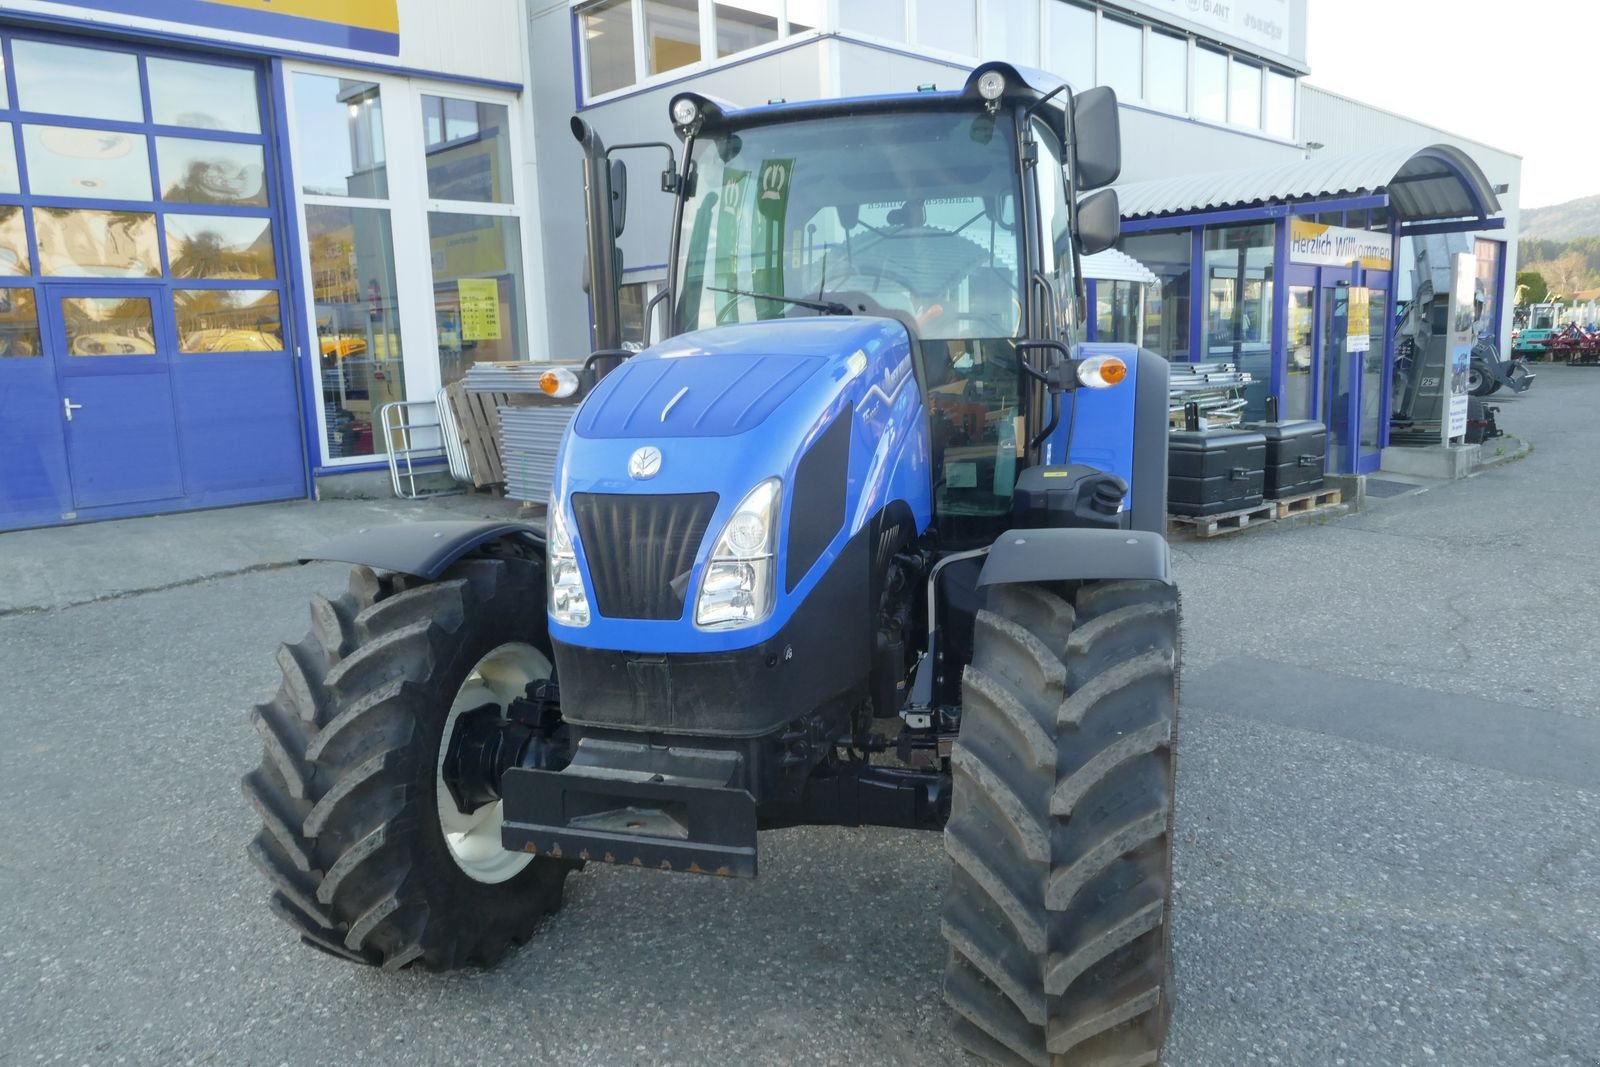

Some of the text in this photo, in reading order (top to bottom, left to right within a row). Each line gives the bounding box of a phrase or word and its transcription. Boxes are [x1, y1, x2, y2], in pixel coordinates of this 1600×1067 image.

[1202, 0, 1230, 19] GIANT
[1292, 231, 1390, 260] Herzlich Willkommen
